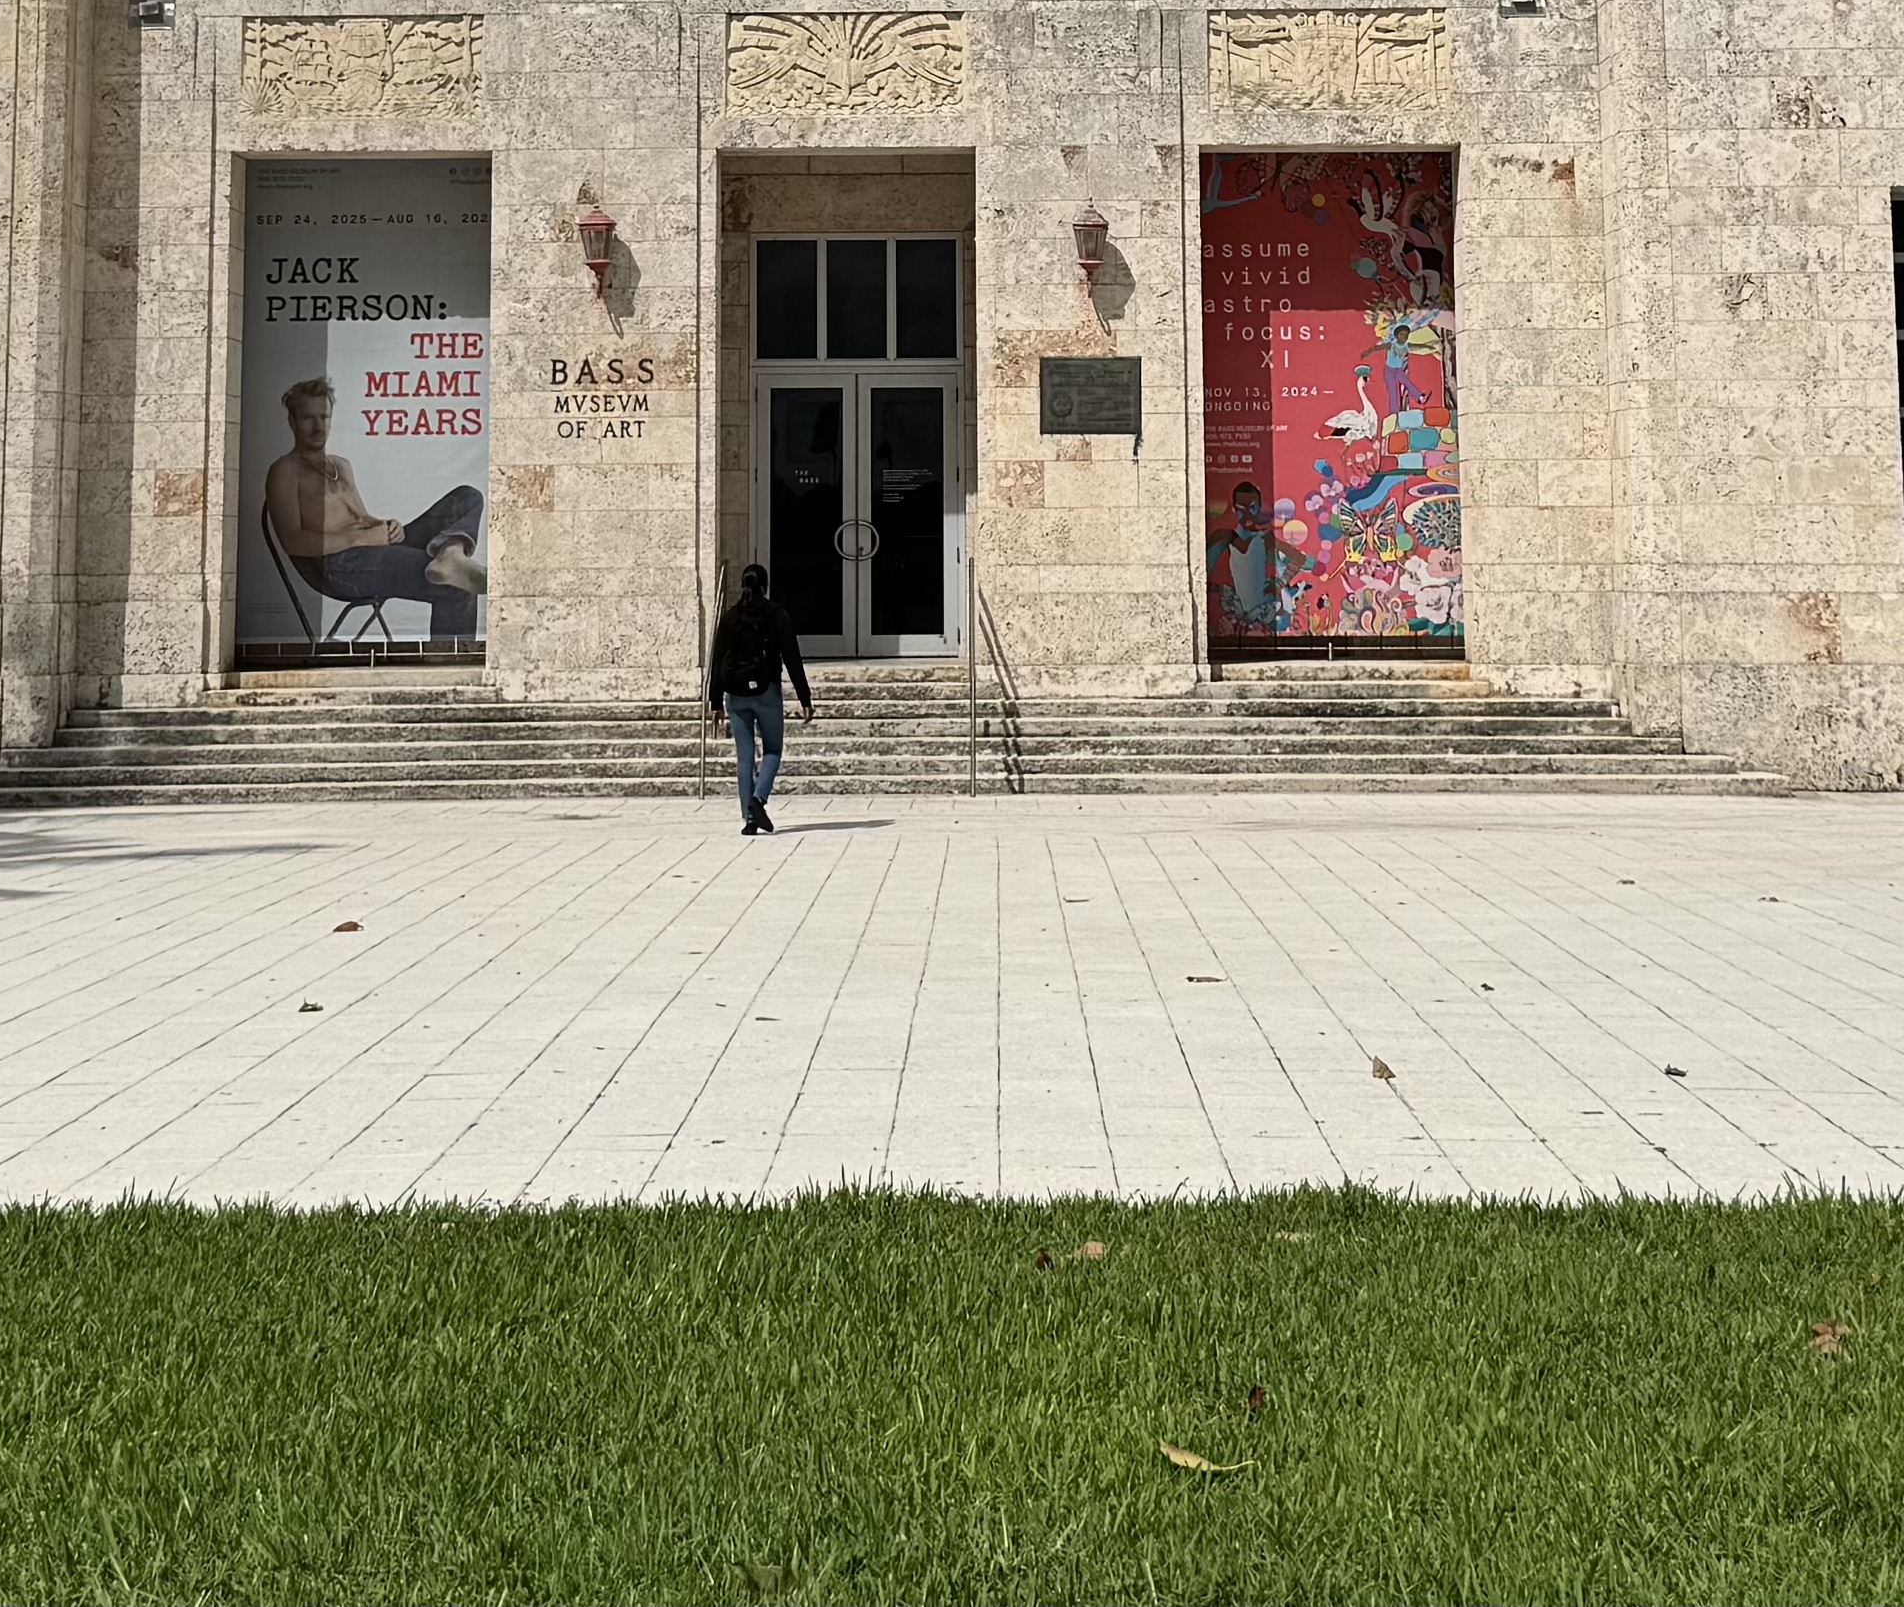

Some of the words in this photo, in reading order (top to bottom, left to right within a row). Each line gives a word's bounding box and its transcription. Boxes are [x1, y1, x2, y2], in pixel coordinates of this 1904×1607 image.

[256, 214, 283, 225] SEP
[461, 212, 489, 224] 202
[1203, 242, 1310, 258] assume
[265, 257, 360, 284] JACK
[1221, 266, 1311, 285] vivid
[265, 294, 448, 322] PIERSON:
[1203, 295, 1292, 313] astro
[1224, 322, 1325, 341] focus:
[410, 332, 484, 359] THE
[1260, 349, 1289, 369] XI
[549, 356, 654, 385] BASS
[364, 370, 482, 398] MIAMI
[1204, 387, 1232, 397] NOV
[553, 394, 649, 413] MVSEVM
[1204, 401, 1271, 412] ONGOING
[360, 408, 483, 436] YEARS
[557, 420, 588, 438] OF
[602, 420, 646, 438] ART
